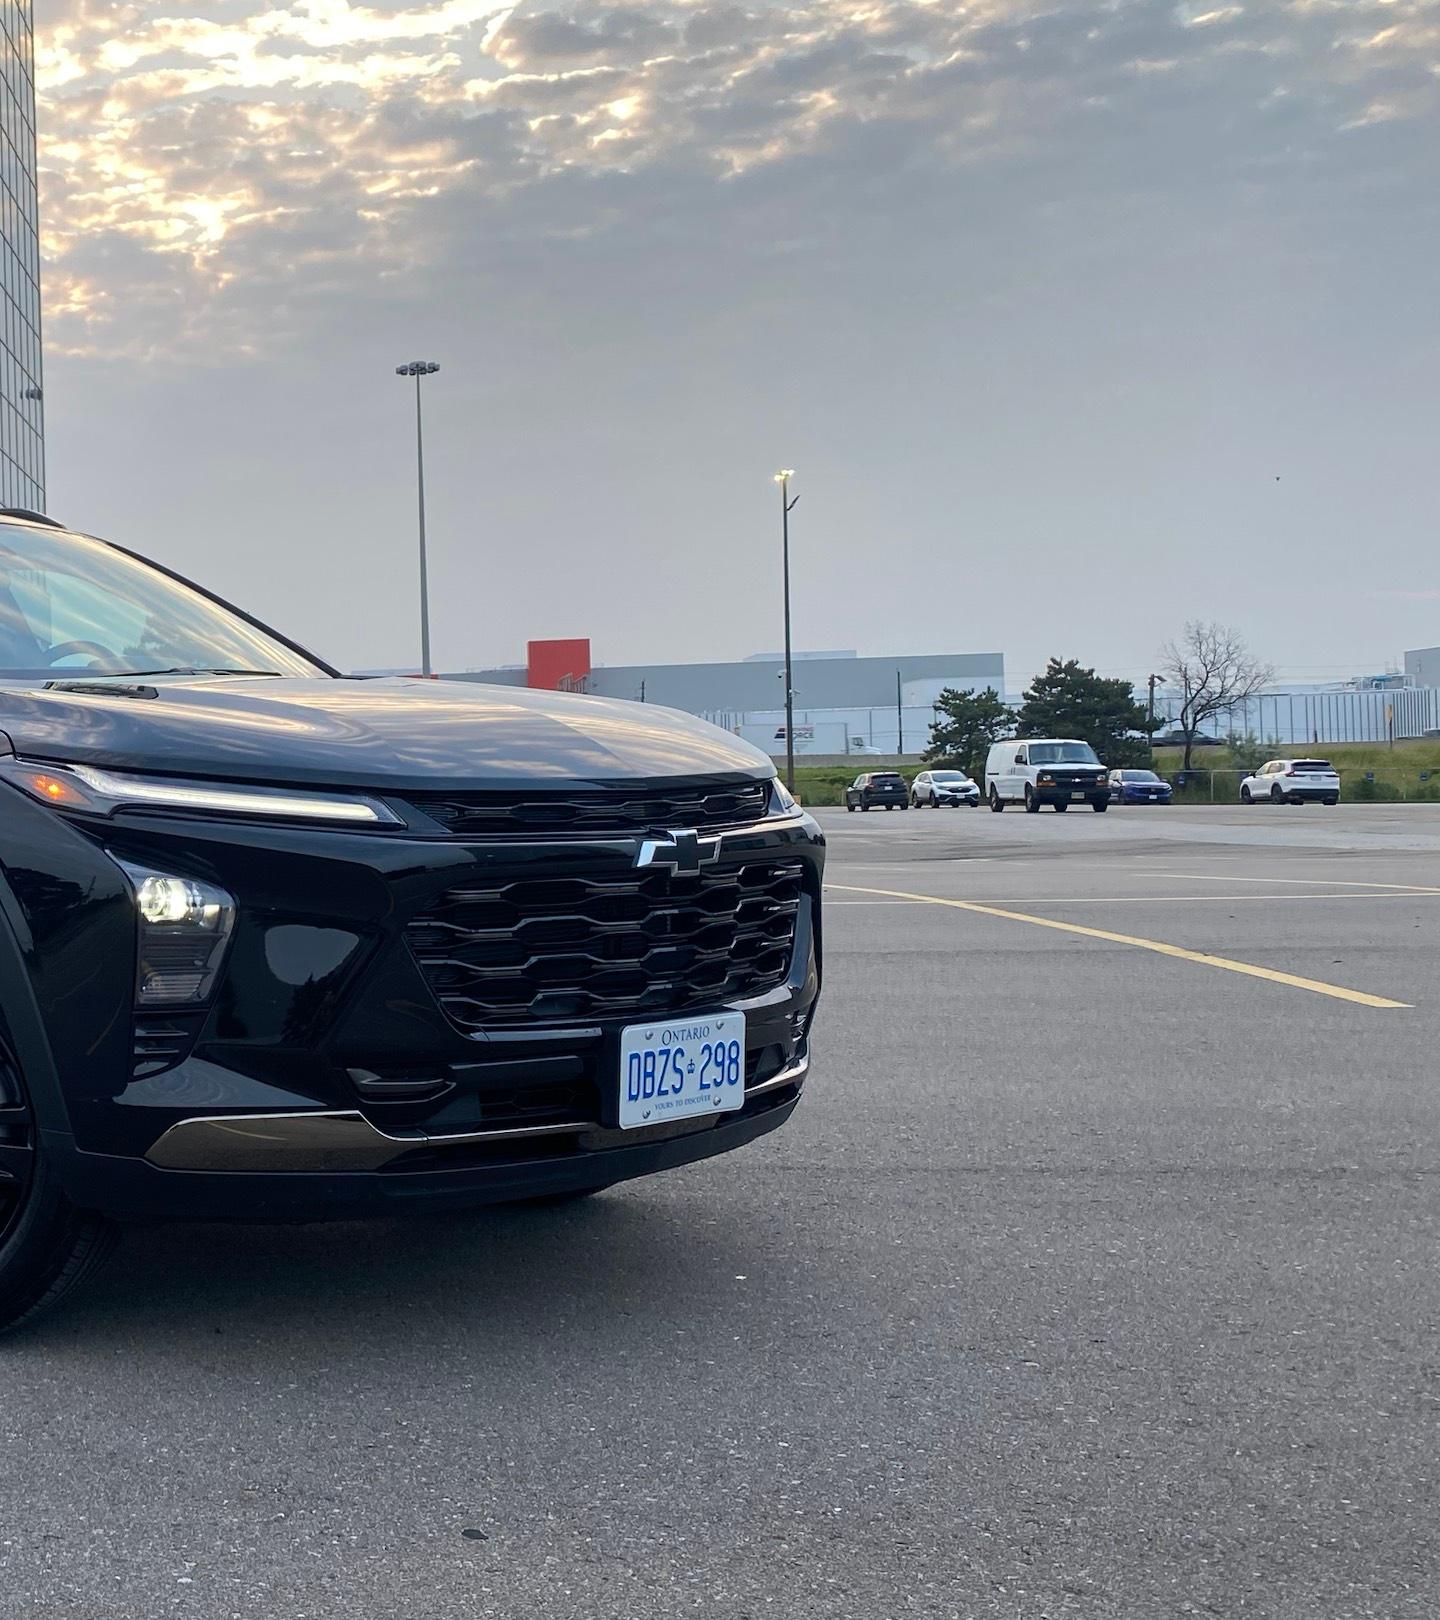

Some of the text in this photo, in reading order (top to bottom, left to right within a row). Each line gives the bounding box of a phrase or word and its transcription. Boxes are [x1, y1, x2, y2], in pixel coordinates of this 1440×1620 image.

[628, 1040, 740, 1103] DBZS 298
[654, 1101, 674, 1110] YOURS
[675, 1099, 684, 1107] TO
